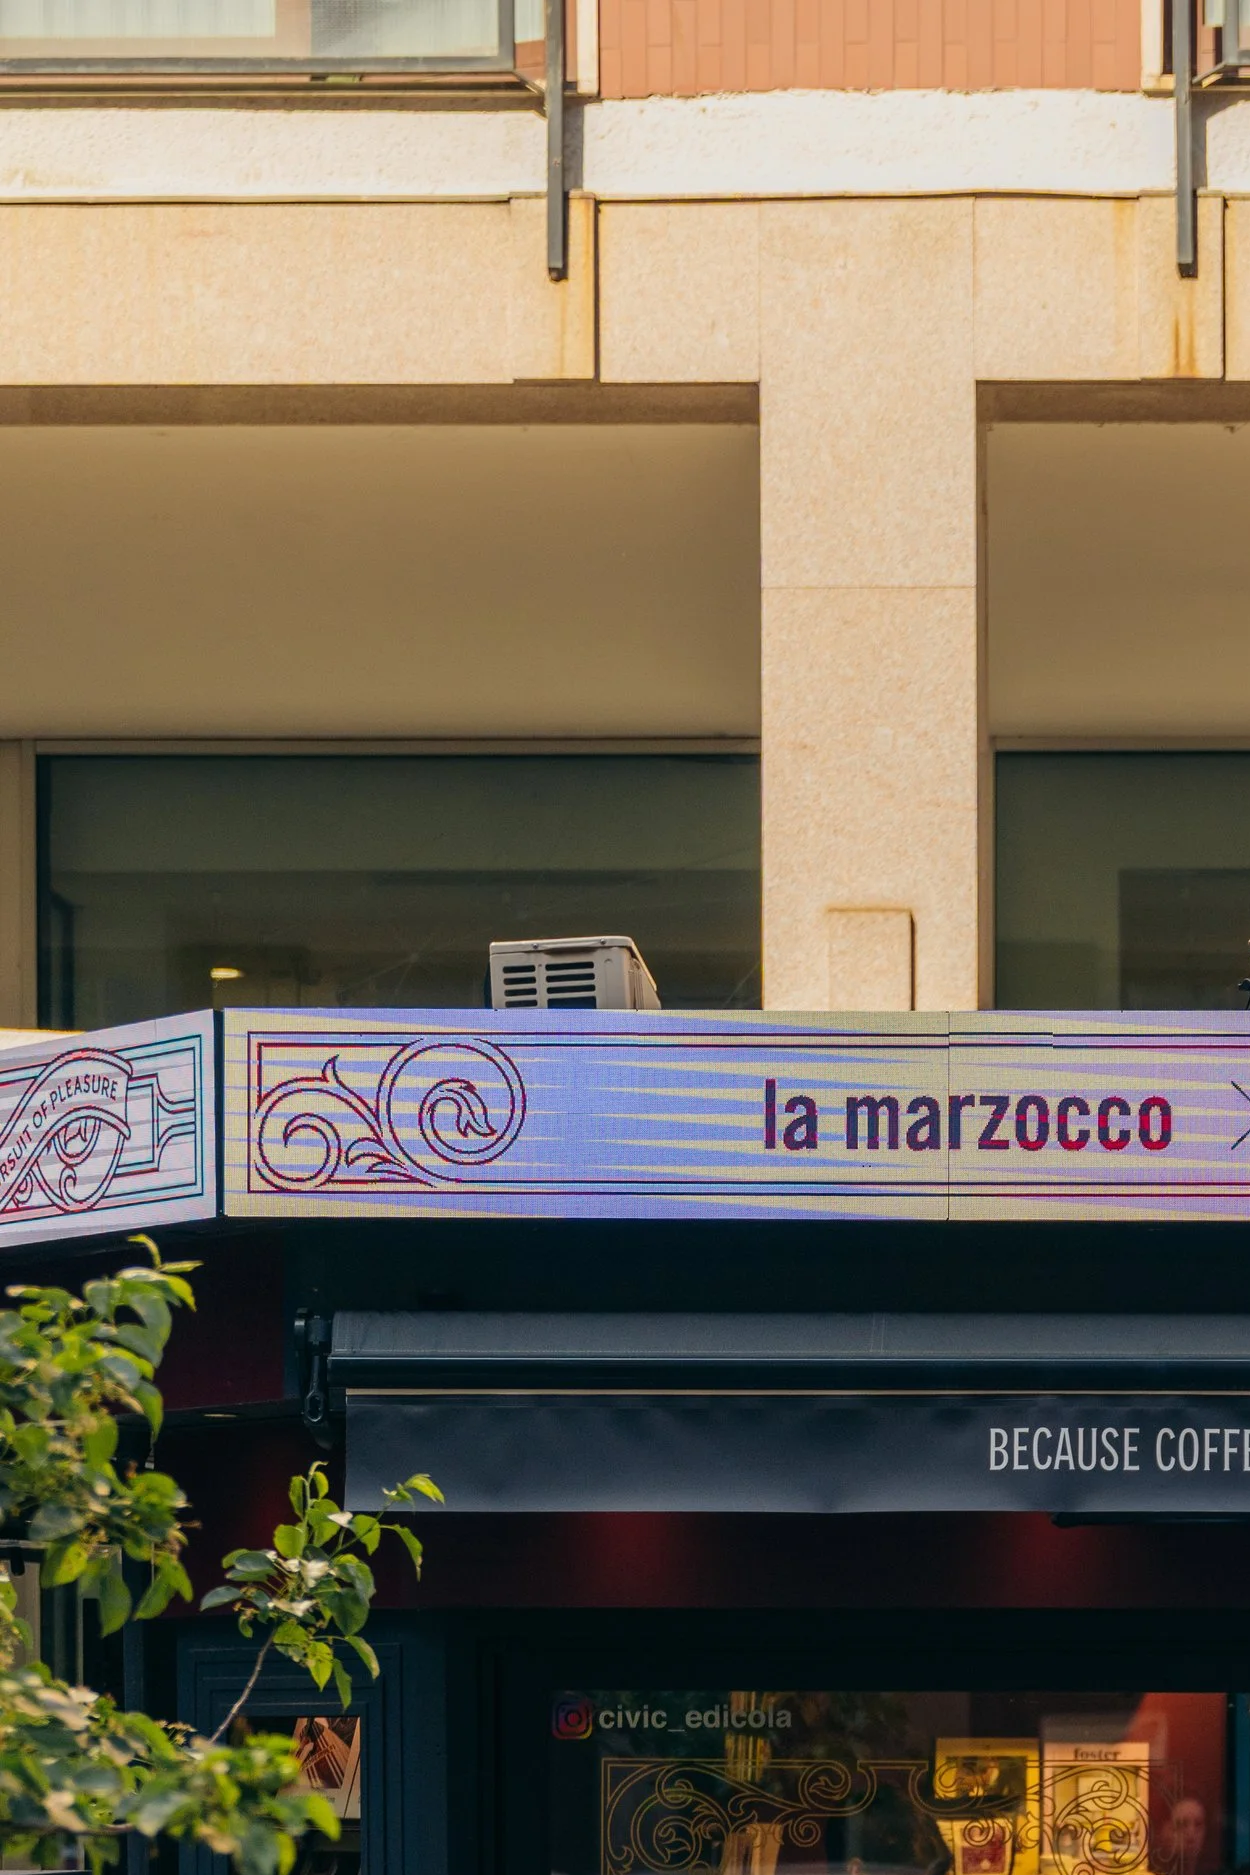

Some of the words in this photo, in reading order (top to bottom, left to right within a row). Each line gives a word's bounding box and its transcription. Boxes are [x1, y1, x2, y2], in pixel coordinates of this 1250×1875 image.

[0, 1125, 32, 1182] RSUIT
[33, 1101, 48, 1128] OF
[50, 1074, 118, 1110] PLEASURE
[763, 1078, 819, 1151] la
[845, 1094, 1173, 1151] marzocco
[989, 1427, 1140, 1471] BECAUSE
[599, 1704, 793, 1732] civic_edicola
